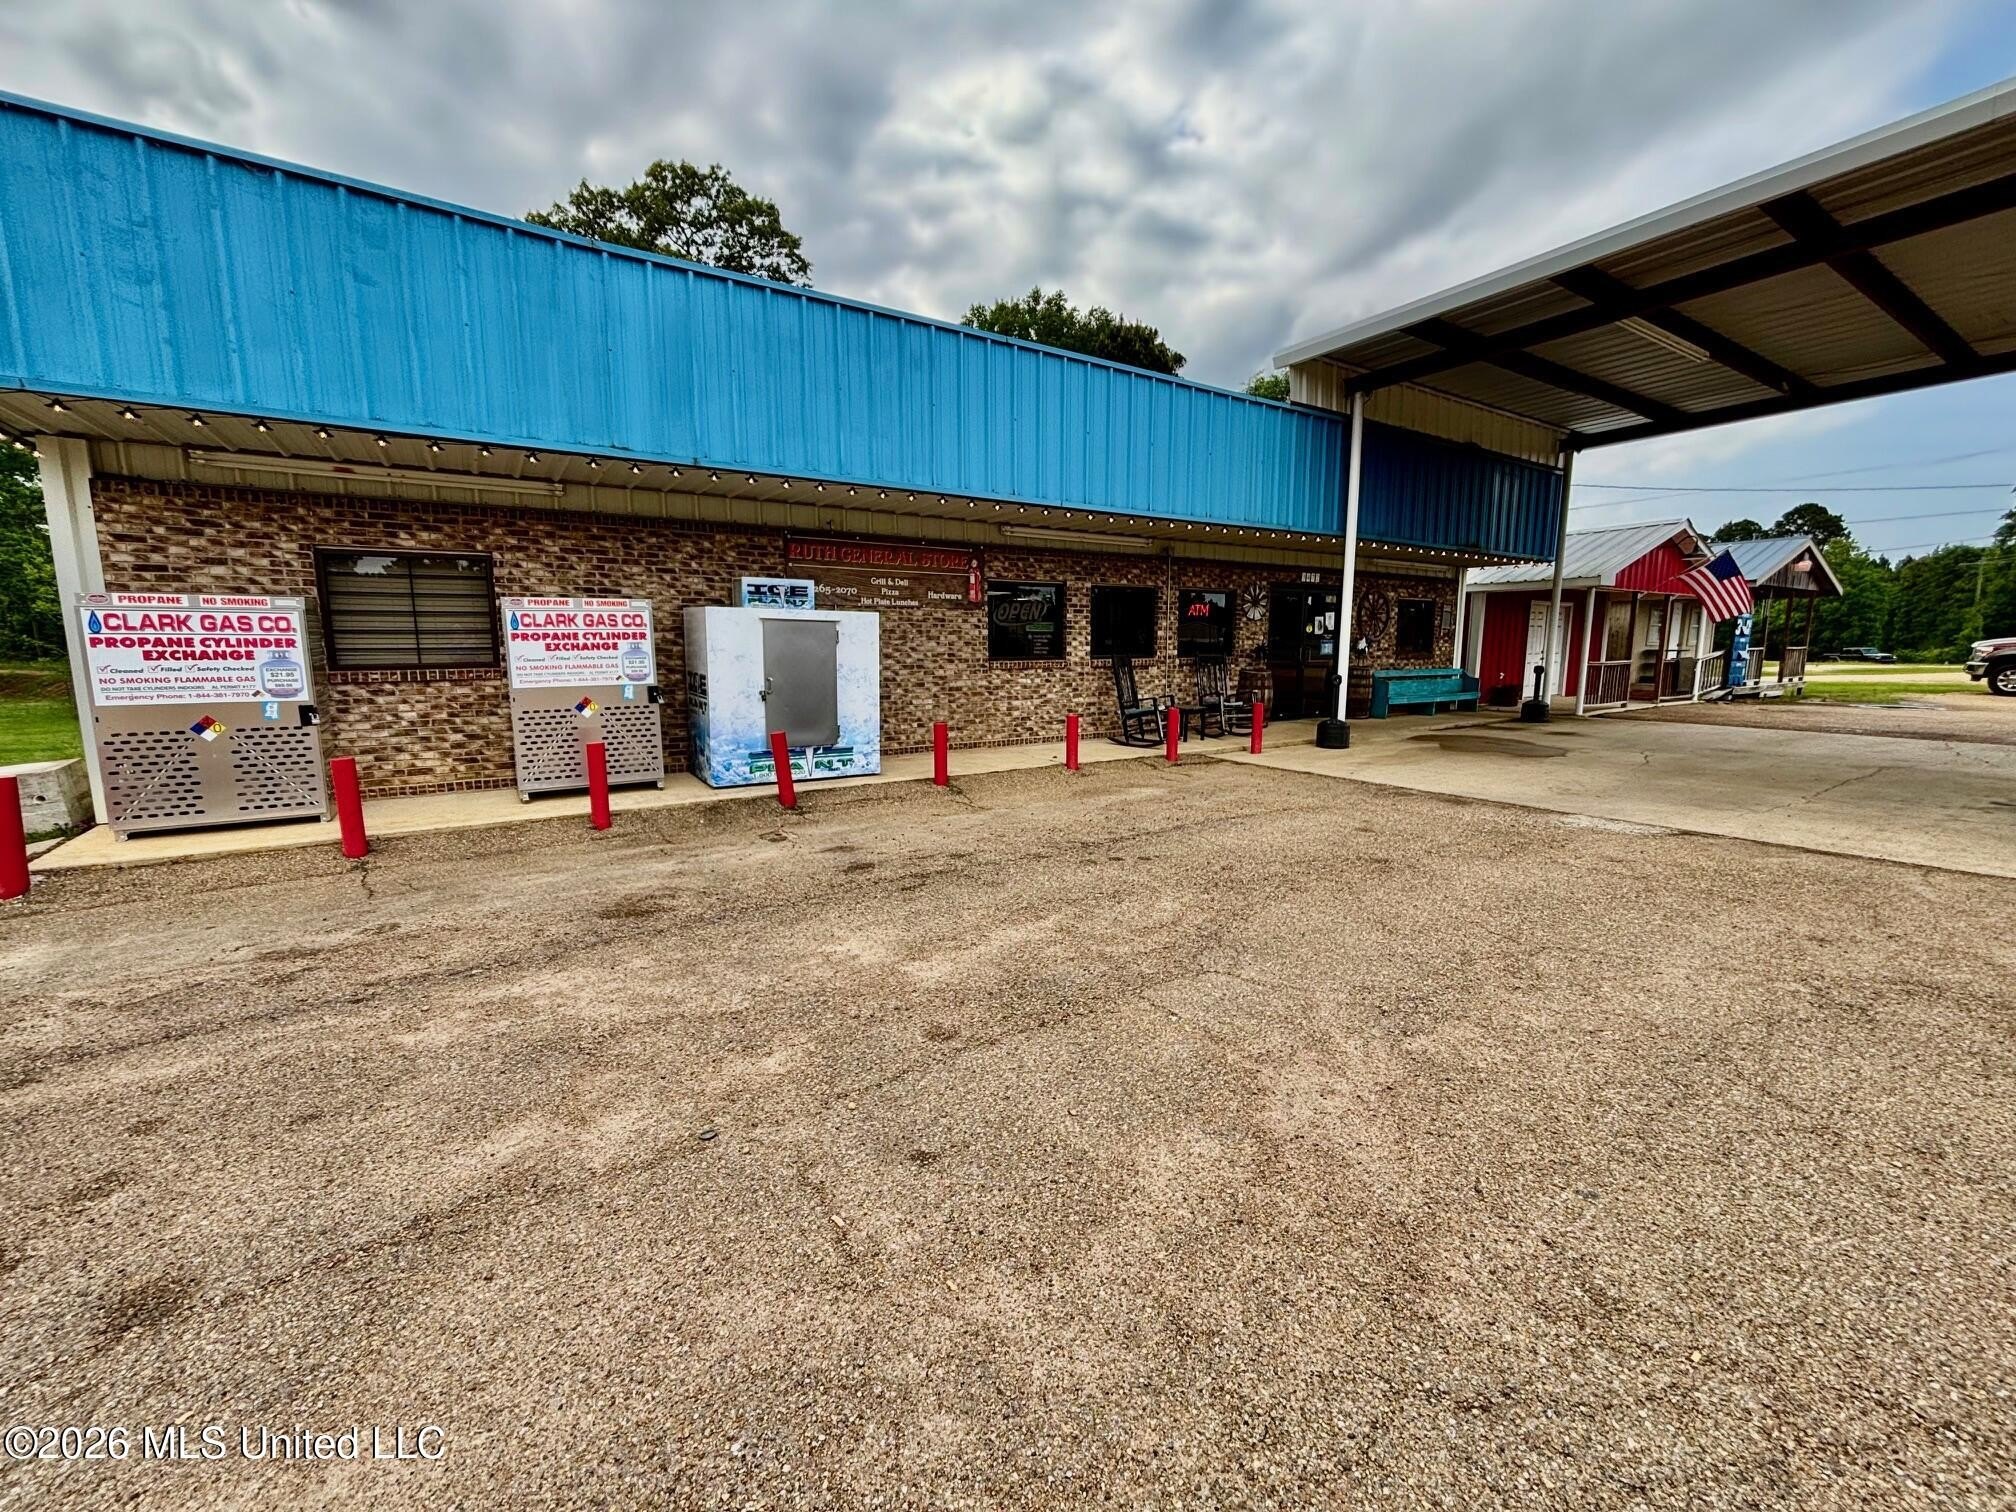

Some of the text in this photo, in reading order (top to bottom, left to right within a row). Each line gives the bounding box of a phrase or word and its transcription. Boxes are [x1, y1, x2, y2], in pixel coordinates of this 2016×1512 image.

[788, 543, 969, 570] RUTH GENERAL STORE
[747, 584, 809, 597] ICE
[814, 583, 858, 596] 265-2070
[881, 588, 899, 596] Pizza
[117, 595, 184, 605] PROPANE
[928, 591, 962, 600] Hardware
[202, 597, 269, 607] NO SMOKING
[527, 599, 570, 607] PROPANE
[861, 597, 919, 606] Hot Plate Lunches
[997, 601, 1041, 620] OPEN
[1188, 604, 1209, 617] ATM
[103, 612, 298, 633] CLARK GAS CO.
[520, 613, 648, 628] CLARK GAS CO.
[510, 632, 648, 642] PROPANE CYLINDER
[89, 636, 298, 649] PROPANE CYLINDER
[545, 642, 619, 652] EXCHANGE
[142, 650, 256, 661] EXCHANGE
[98, 677, 117, 685] NO
[120, 676, 171, 684] SMOKING
